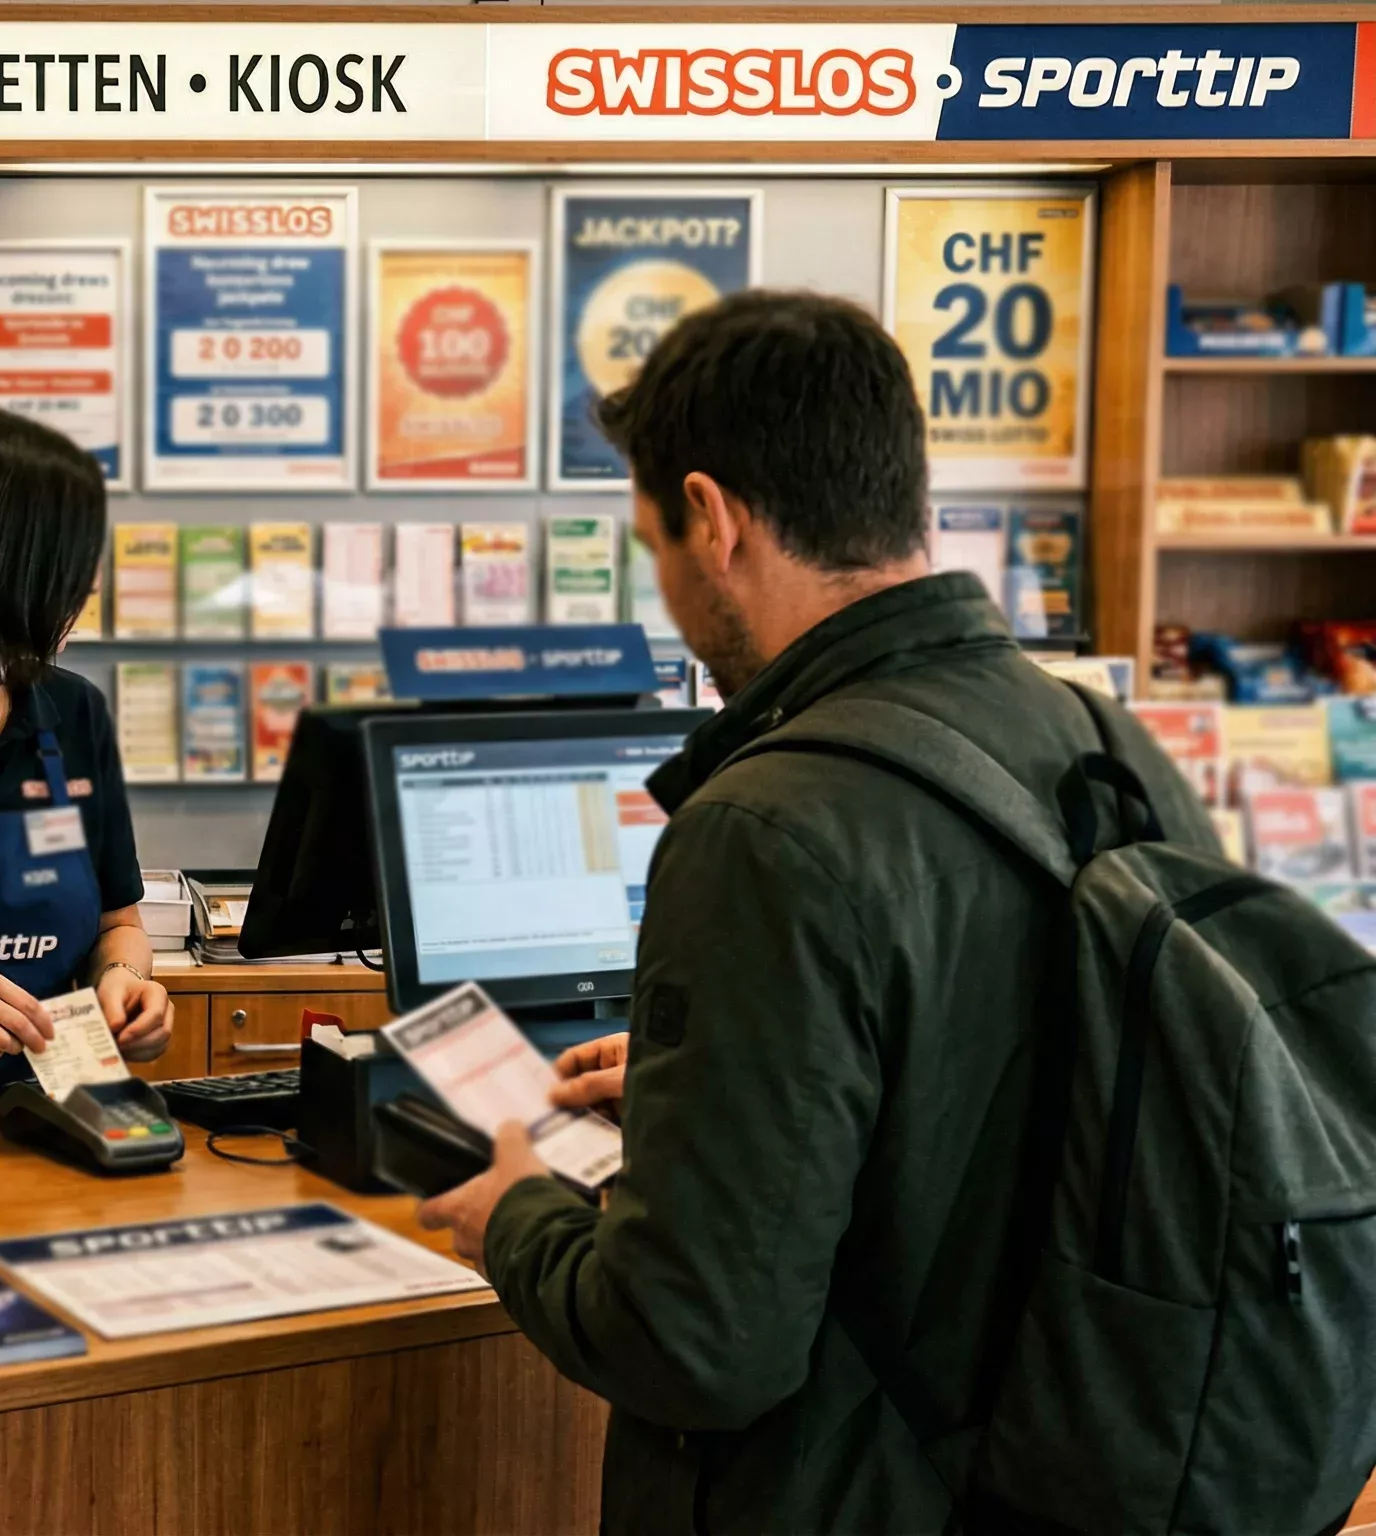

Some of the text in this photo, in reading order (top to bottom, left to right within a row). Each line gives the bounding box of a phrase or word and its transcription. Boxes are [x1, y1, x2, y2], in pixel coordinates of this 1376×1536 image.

[230, 53, 408, 113] KIOSK
[546, 48, 917, 117] SWISSLOS
[168, 205, 333, 238] SWISSLOS
[576, 217, 741, 247] JACKPOT?
[942, 231, 1045, 274] CHF
[930, 282, 1053, 362] 20
[198, 335, 215, 361] 2
[248, 335, 303, 361] 200
[197, 403, 215, 428] 2
[249, 403, 305, 428] 300
[930, 369, 1052, 419] MIO
